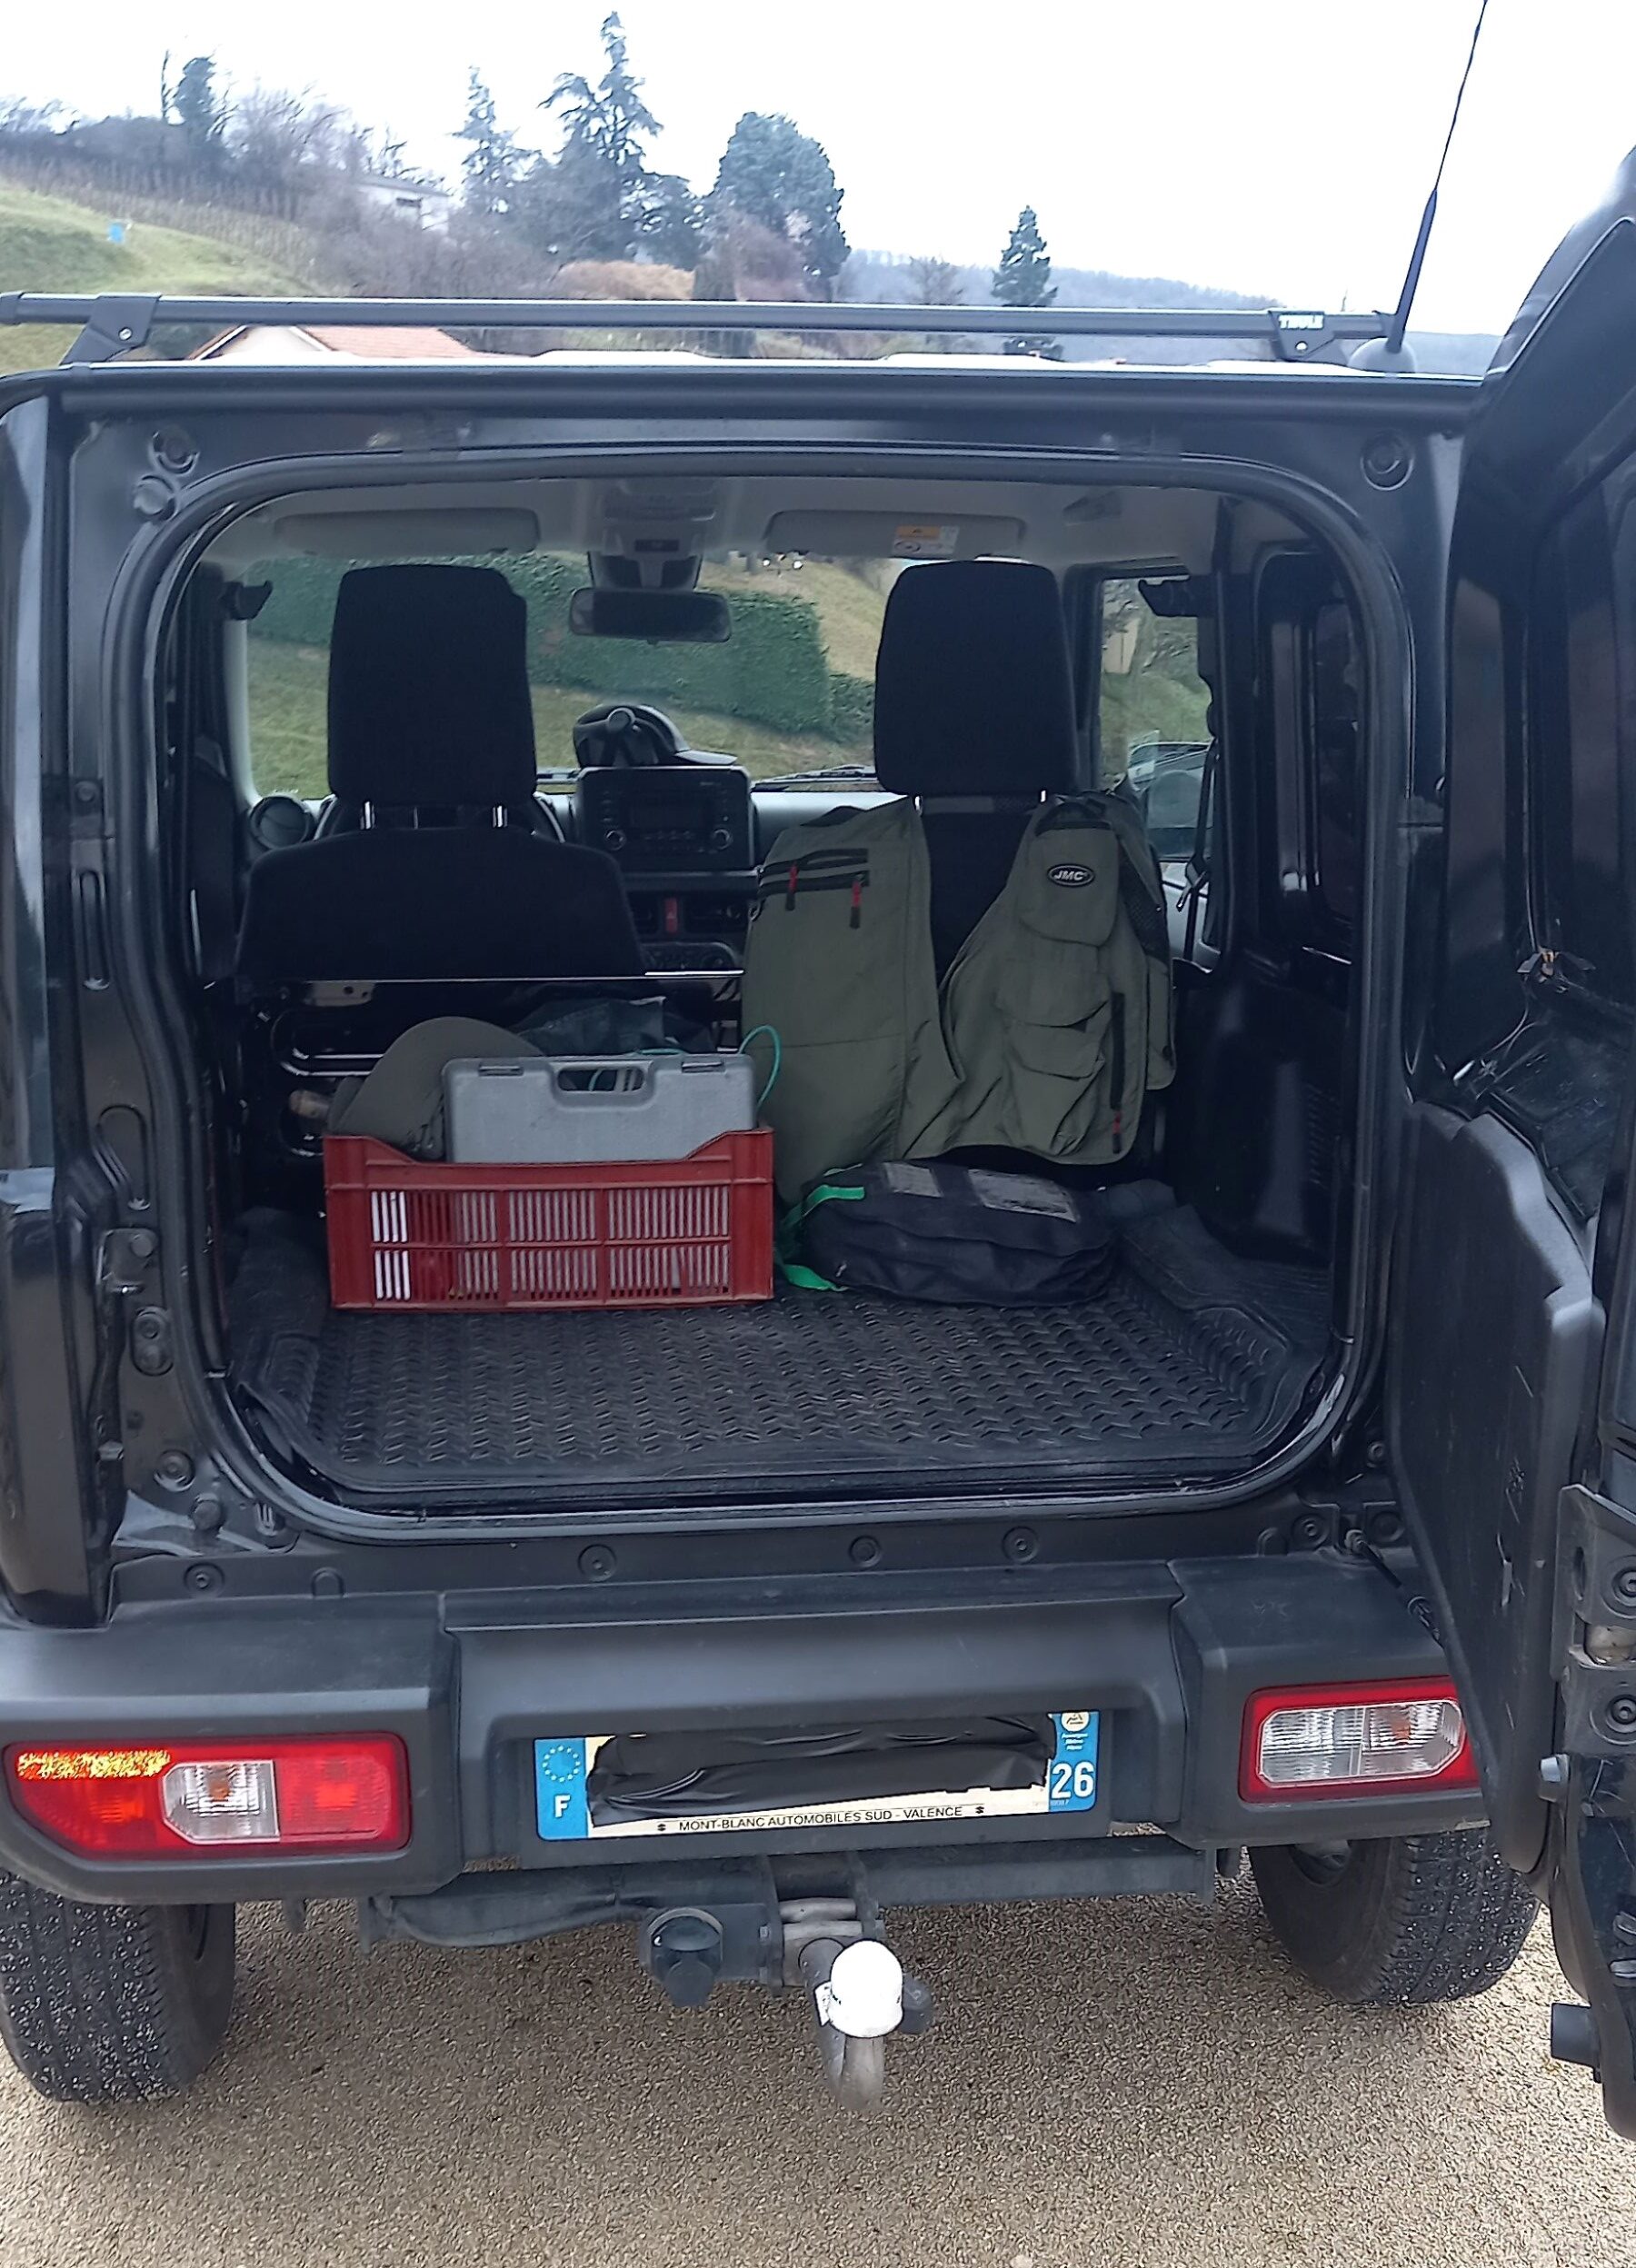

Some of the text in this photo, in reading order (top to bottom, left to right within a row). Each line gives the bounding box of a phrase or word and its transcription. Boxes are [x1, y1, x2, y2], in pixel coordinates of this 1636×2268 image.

[1054, 870, 1086, 881] JMC
[1051, 1761, 1095, 1800] 26
[554, 1794, 572, 1818] F
[679, 1816, 765, 1832] MONT-BLANC
[767, 1811, 862, 1826] AUTOMOBILES
[864, 1810, 893, 1822] SUD
[903, 1805, 963, 1820] VALENCE
